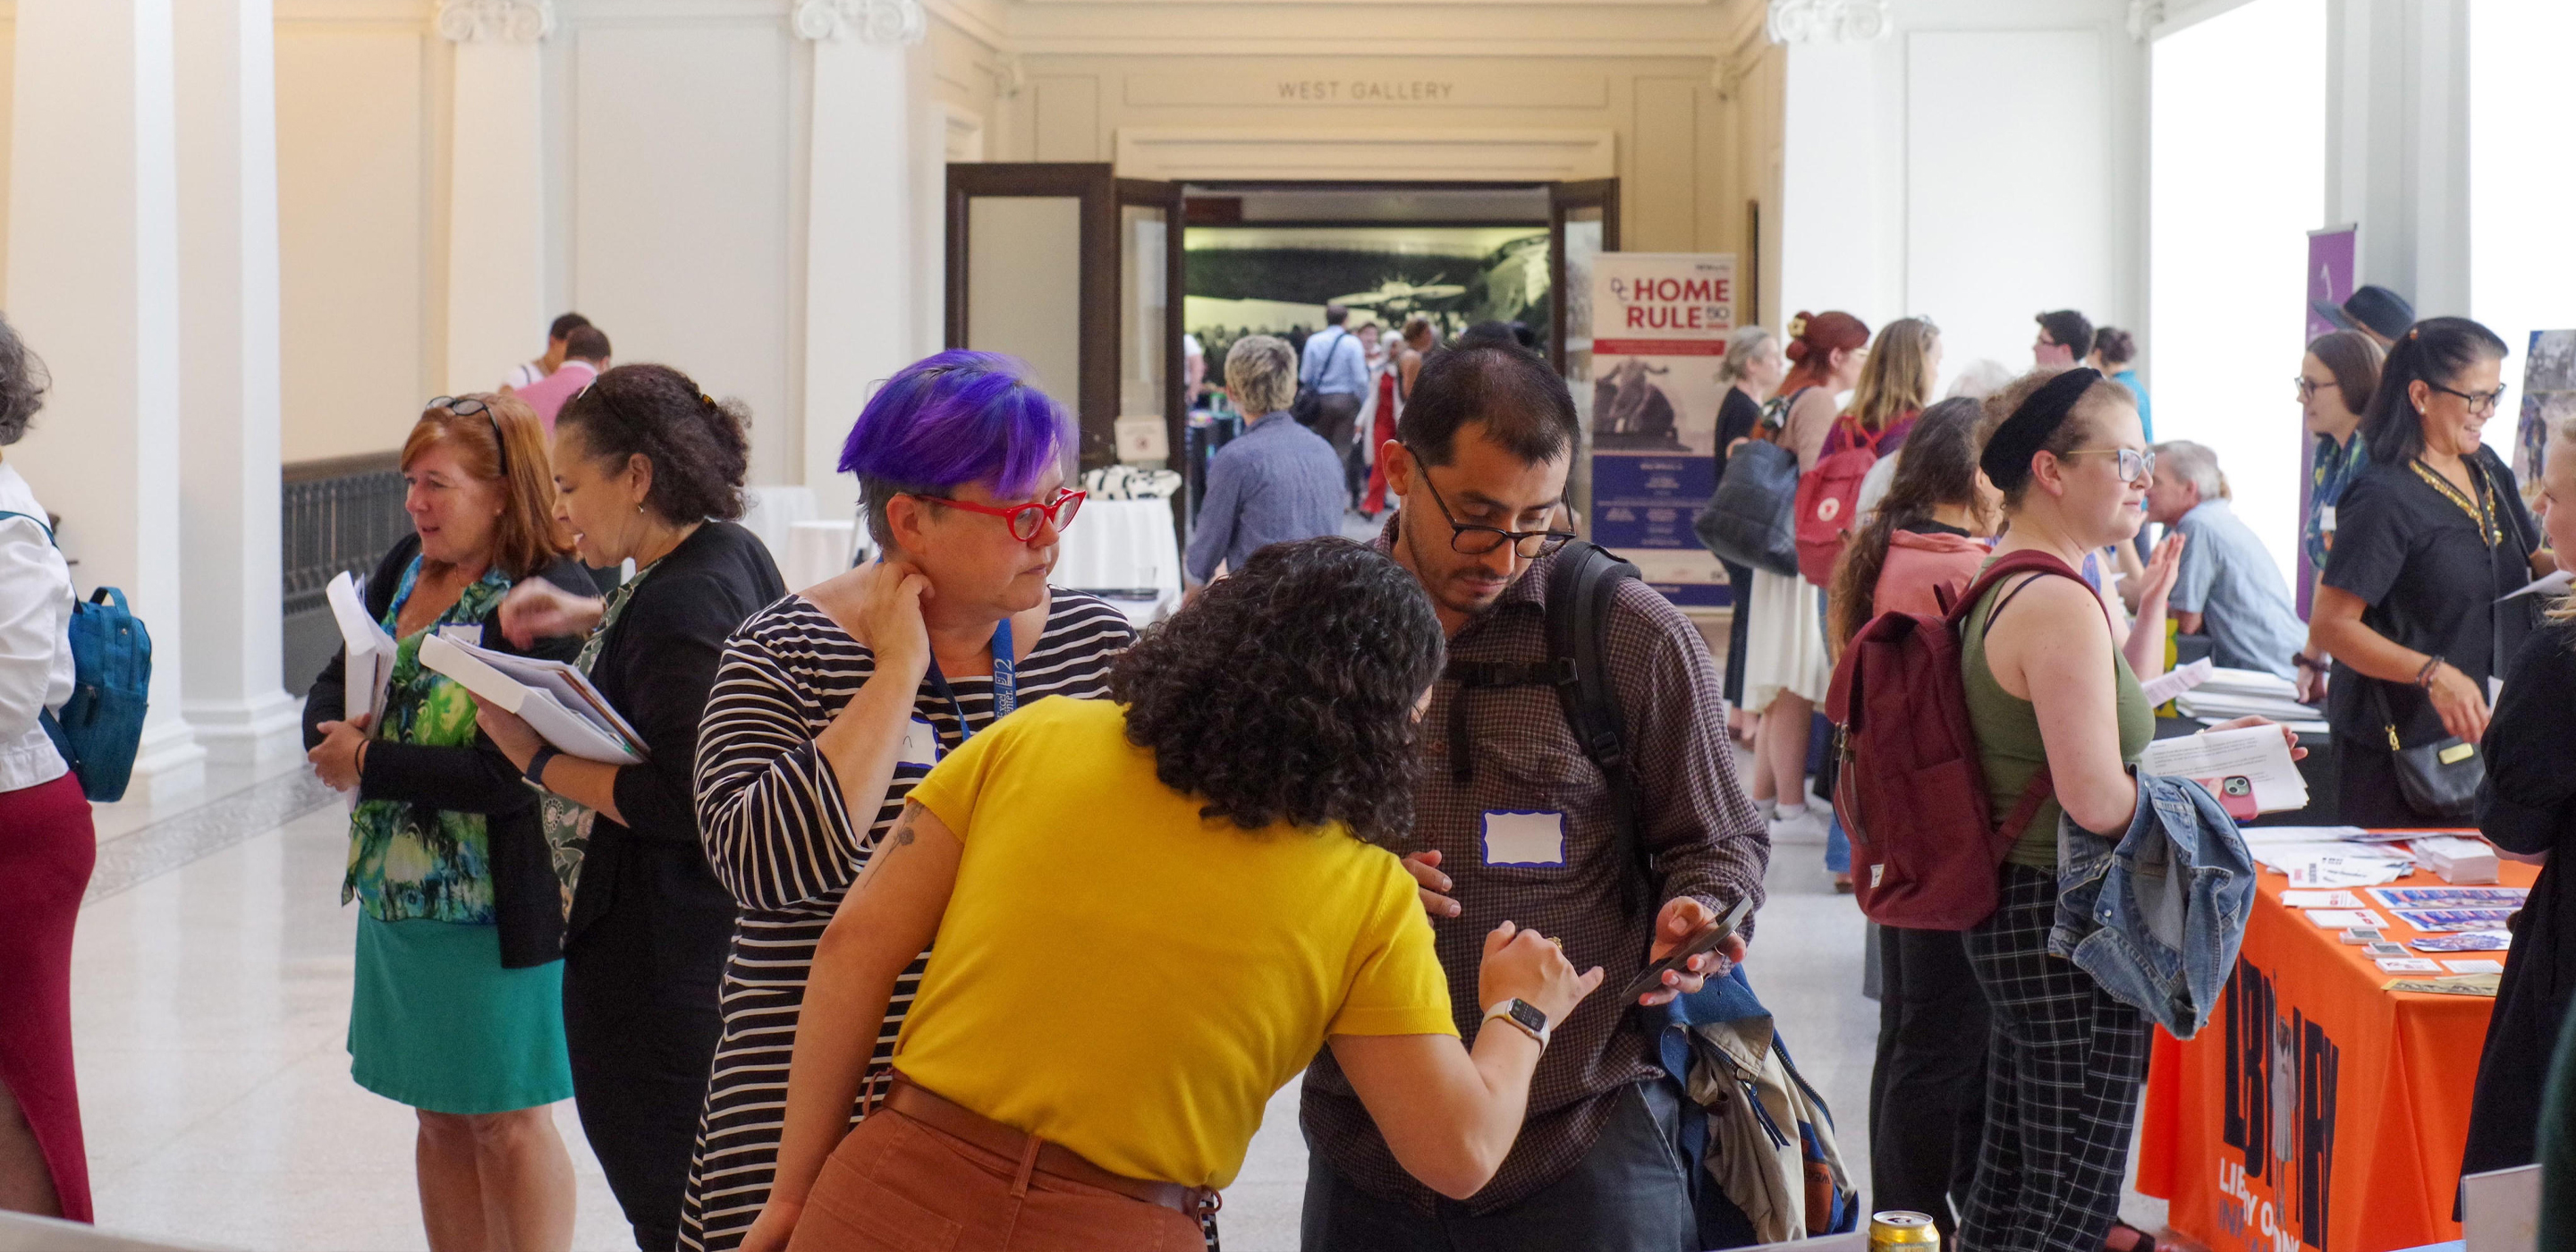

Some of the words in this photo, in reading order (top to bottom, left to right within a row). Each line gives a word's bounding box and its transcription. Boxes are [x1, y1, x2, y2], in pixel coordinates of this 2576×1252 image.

[1277, 80, 1340, 100] WEST
[1350, 80, 1453, 100] GALLERY
[1633, 277, 1730, 302] HOME
[1626, 305, 1703, 329] RULE
[996, 692, 1006, 719] Excel
[1005, 689, 1014, 714] enter
